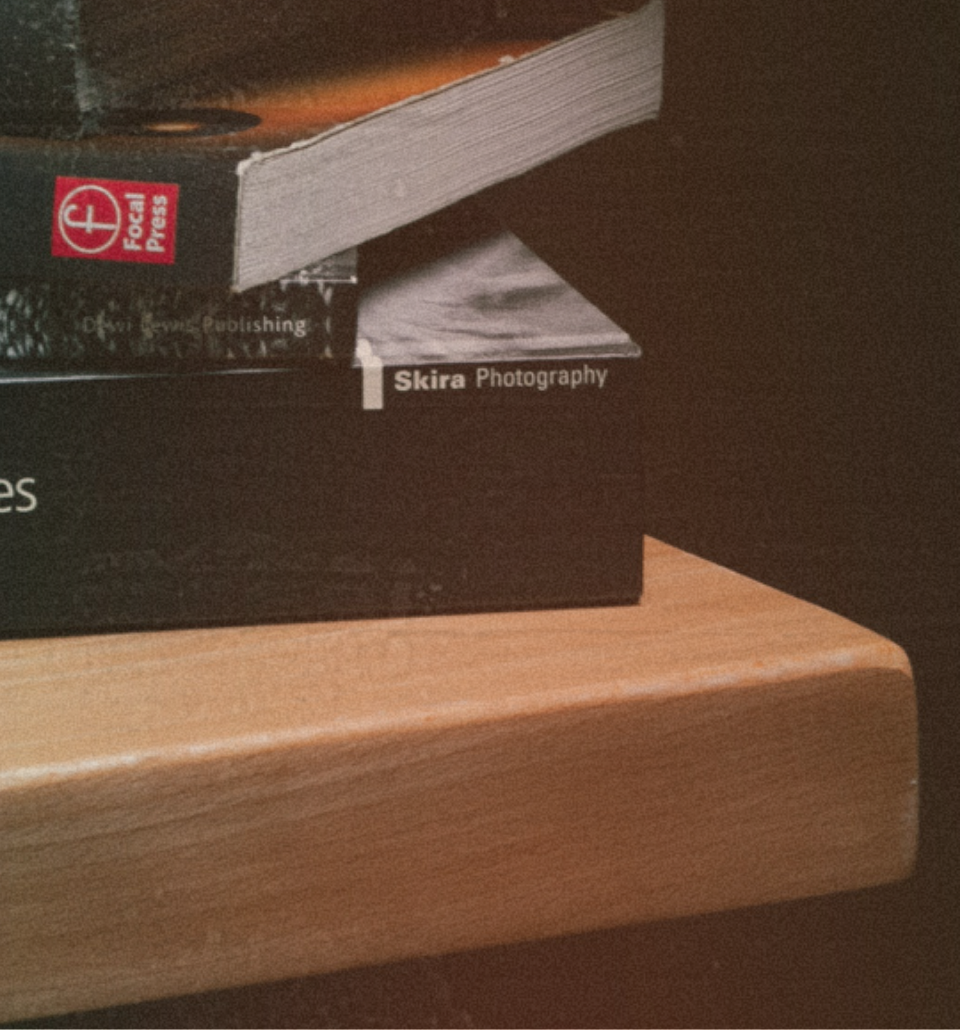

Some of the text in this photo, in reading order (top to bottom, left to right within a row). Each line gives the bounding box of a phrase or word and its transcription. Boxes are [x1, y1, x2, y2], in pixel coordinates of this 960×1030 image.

[123, 192, 145, 251] Focal
[145, 195, 168, 253] Press
[202, 316, 308, 338] Publishing
[394, 364, 608, 392] Skira Photography
